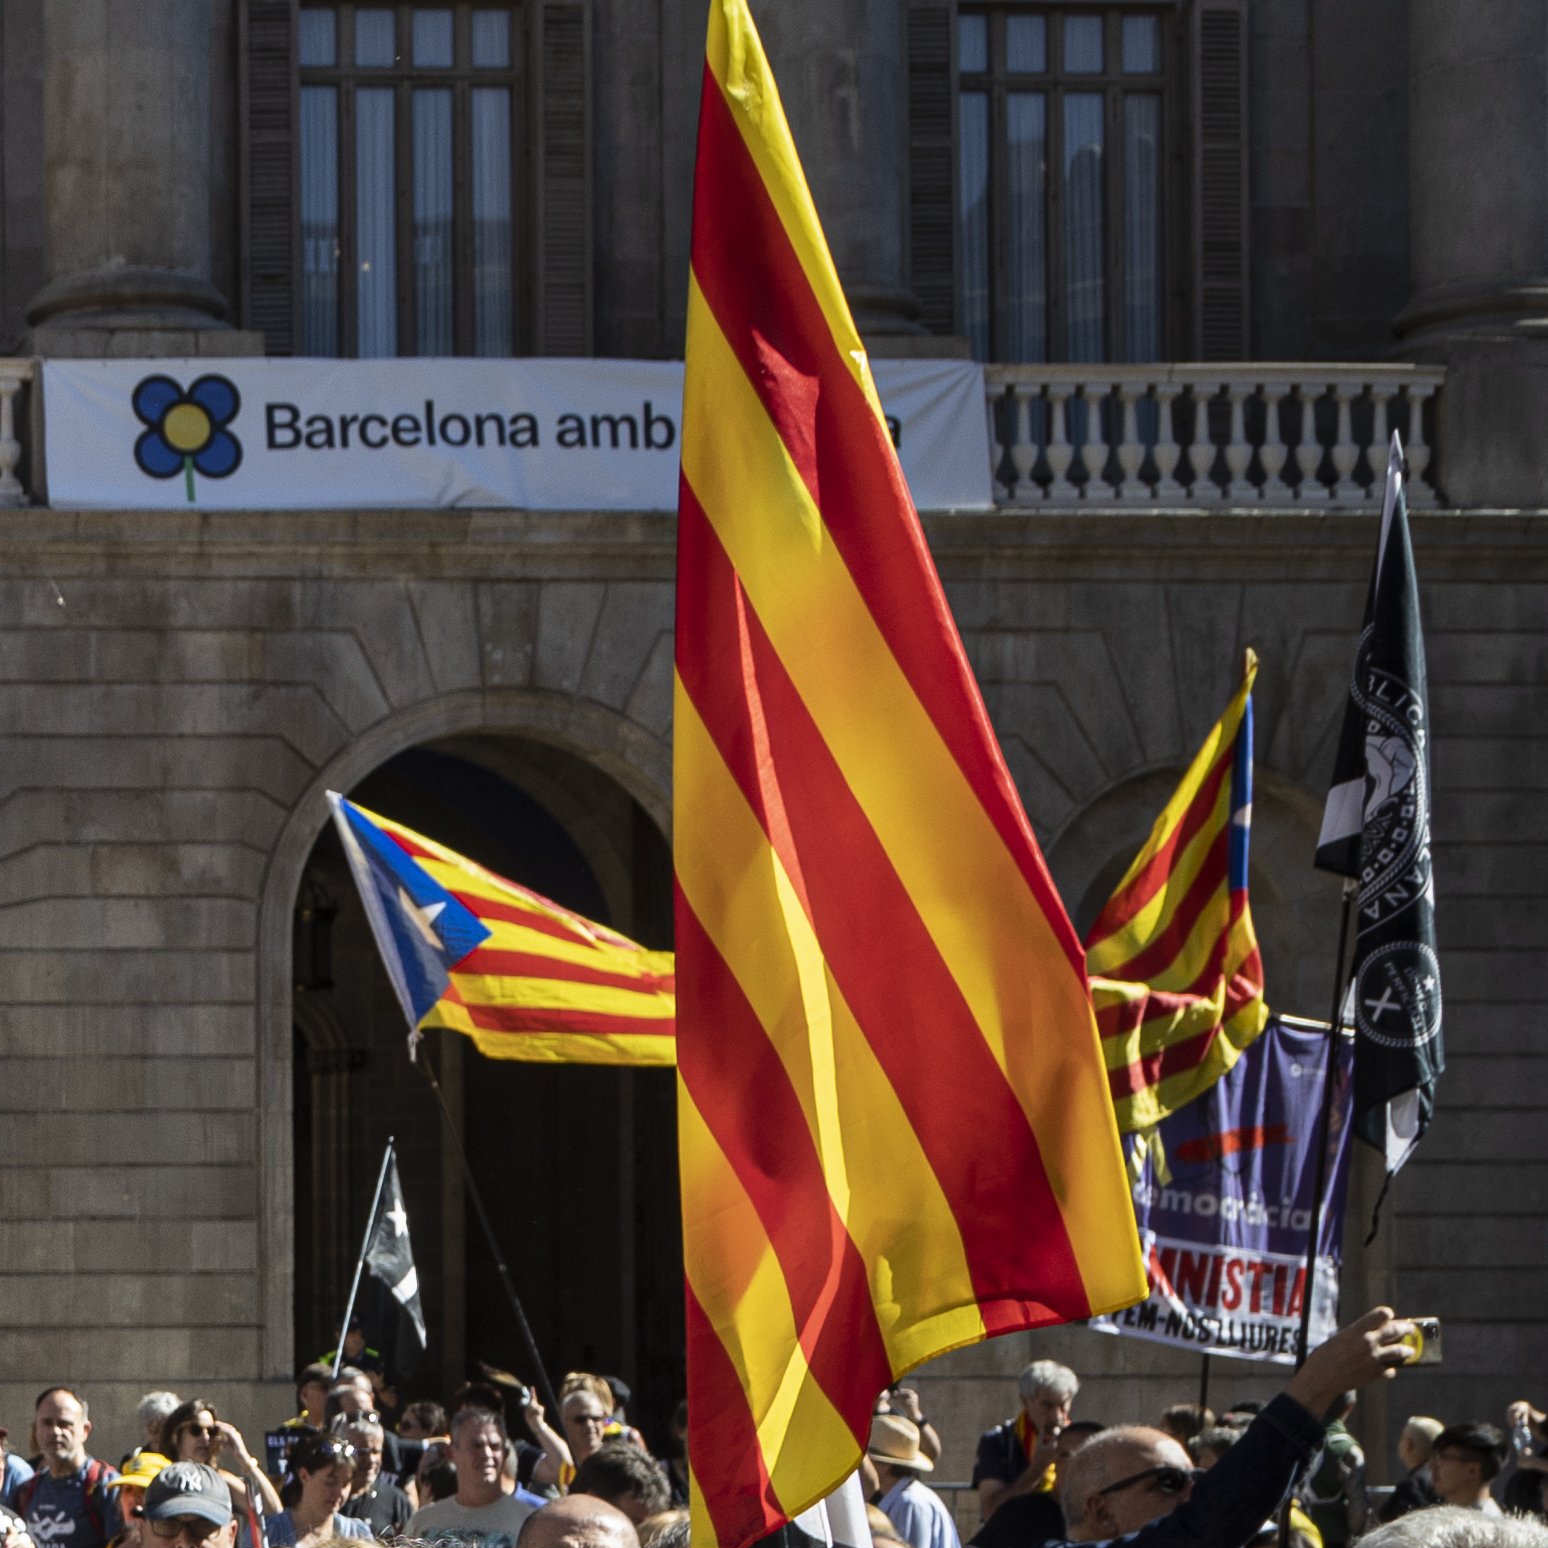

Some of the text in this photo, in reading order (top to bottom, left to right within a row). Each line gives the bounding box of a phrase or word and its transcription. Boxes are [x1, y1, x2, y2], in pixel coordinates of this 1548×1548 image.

[265, 401, 676, 450] Barcelona amb
[181, 1470, 202, 1492] NY
